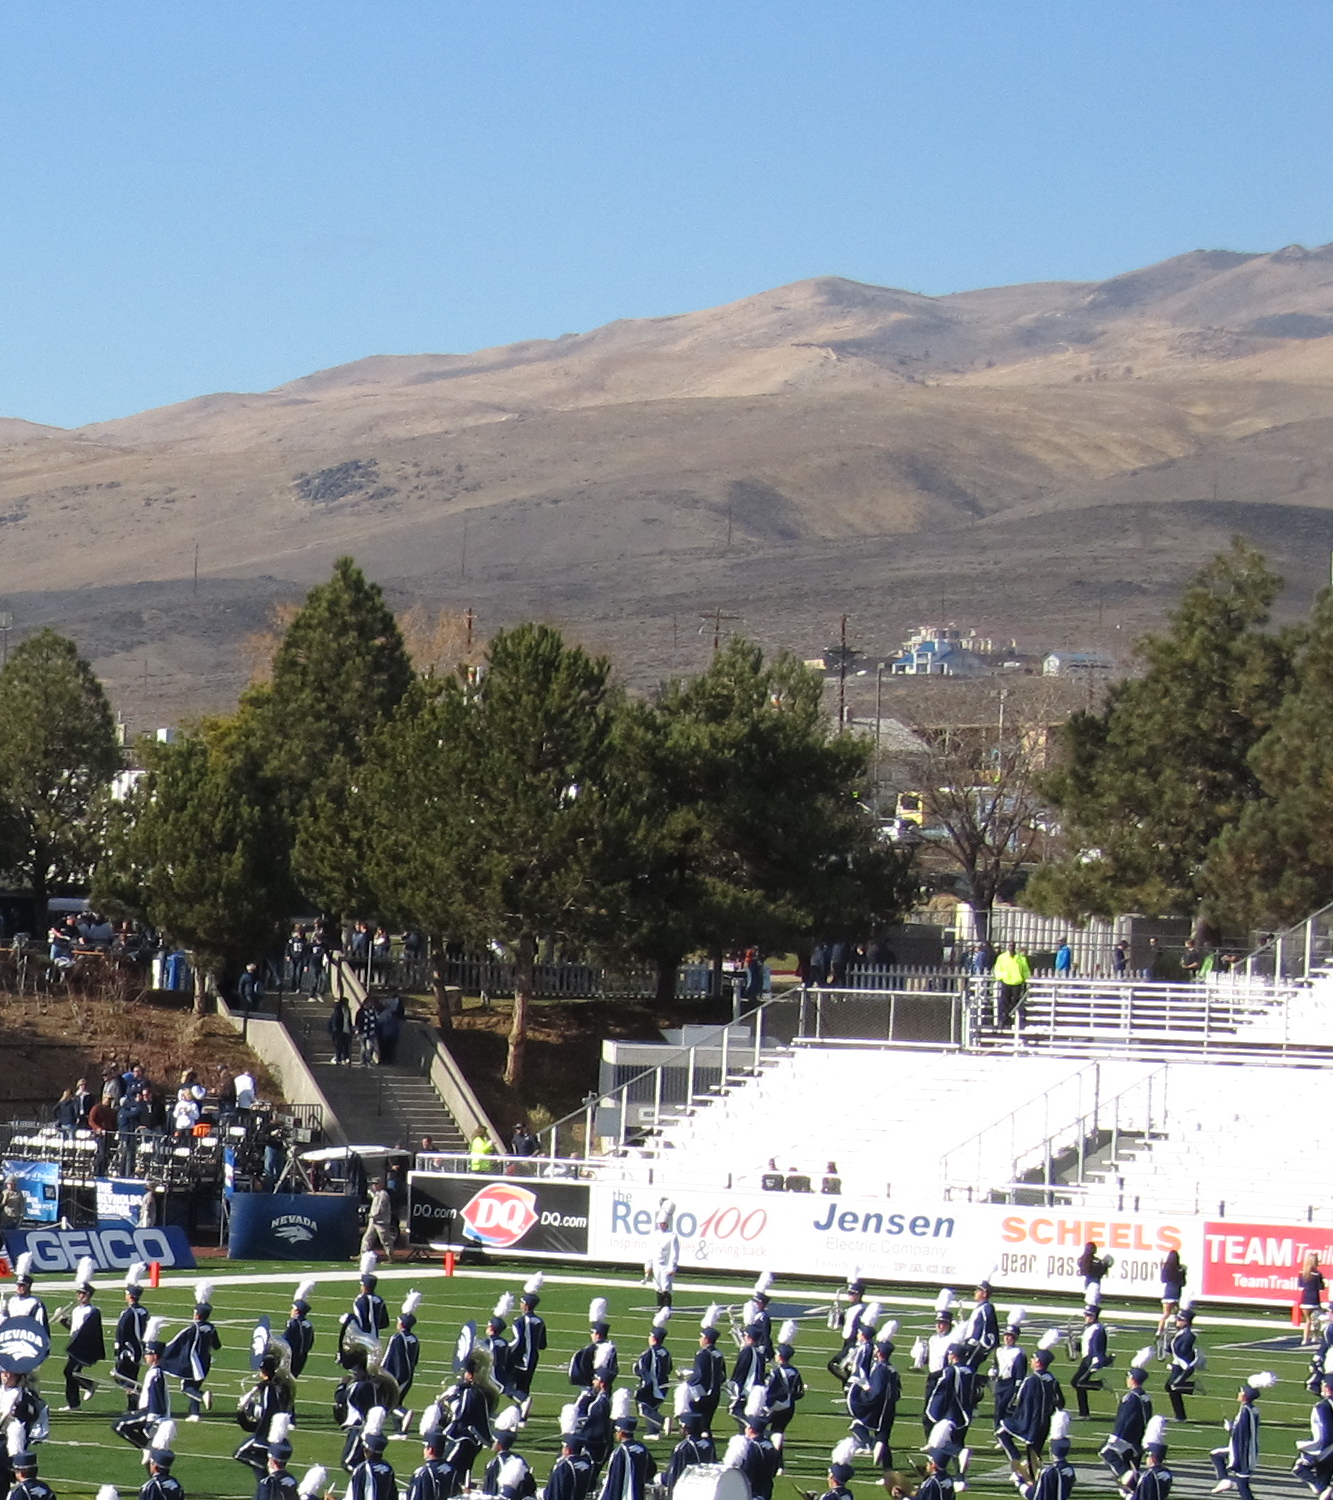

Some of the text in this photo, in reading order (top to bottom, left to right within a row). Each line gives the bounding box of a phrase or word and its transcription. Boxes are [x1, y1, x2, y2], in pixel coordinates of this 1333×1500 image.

[613, 1189, 633, 1203] the
[270, 1214, 318, 1233] NEVADA
[413, 1203, 457, 1220] DQ.com
[476, 1196, 527, 1229] DQ
[540, 1211, 587, 1229] DQ.com
[699, 1206, 768, 1242] 100
[813, 1203, 955, 1238] Jensen
[608, 1237, 648, 1251] Inspirin
[1001, 1216, 1183, 1252] SCHEELS
[25, 1228, 176, 1271] GEICO
[825, 1236, 948, 1260] Electric Company
[1206, 1233, 1292, 1268] TEAM
[1120, 1255, 1166, 1281] sport
